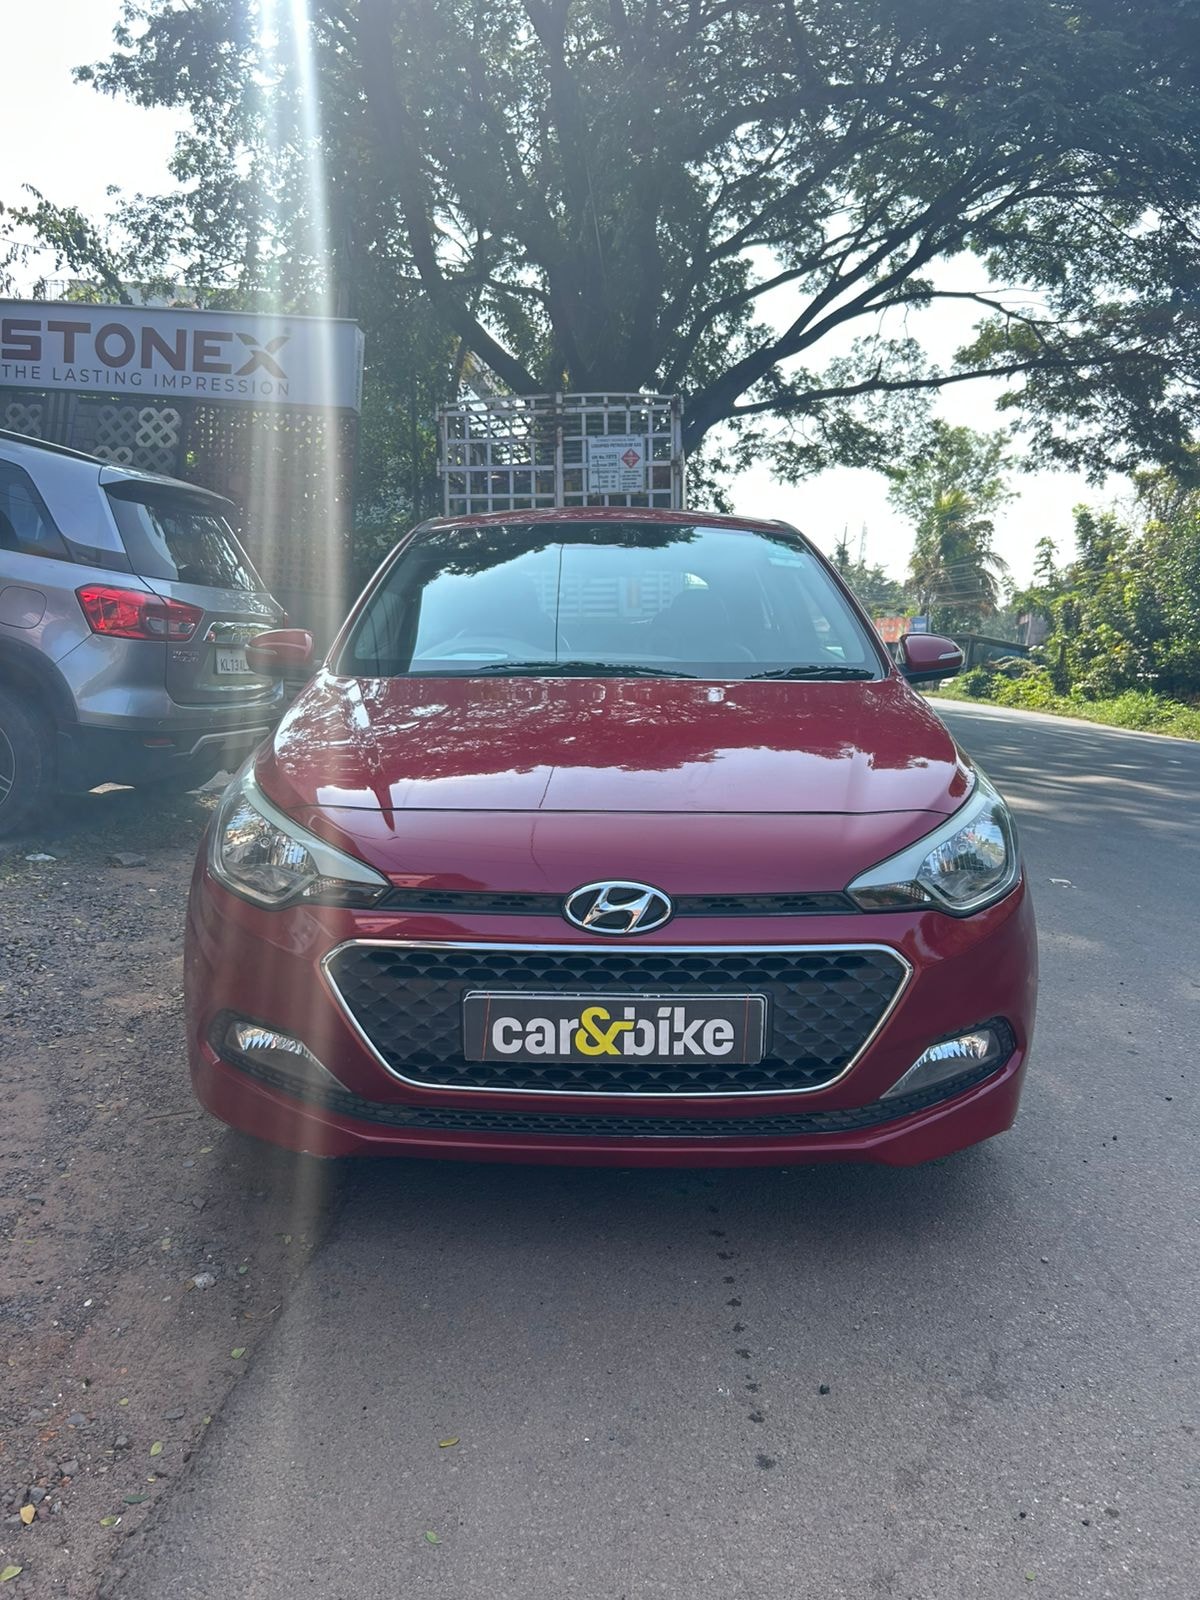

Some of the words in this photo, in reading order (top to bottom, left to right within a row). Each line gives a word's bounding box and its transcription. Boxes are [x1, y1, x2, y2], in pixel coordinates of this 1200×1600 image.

[1, 318, 291, 380] STONEX
[1, 364, 41, 380] THE
[52, 367, 143, 386] LASTING
[154, 374, 290, 397] IMPRESSION
[492, 1006, 734, 1056] car&bike
